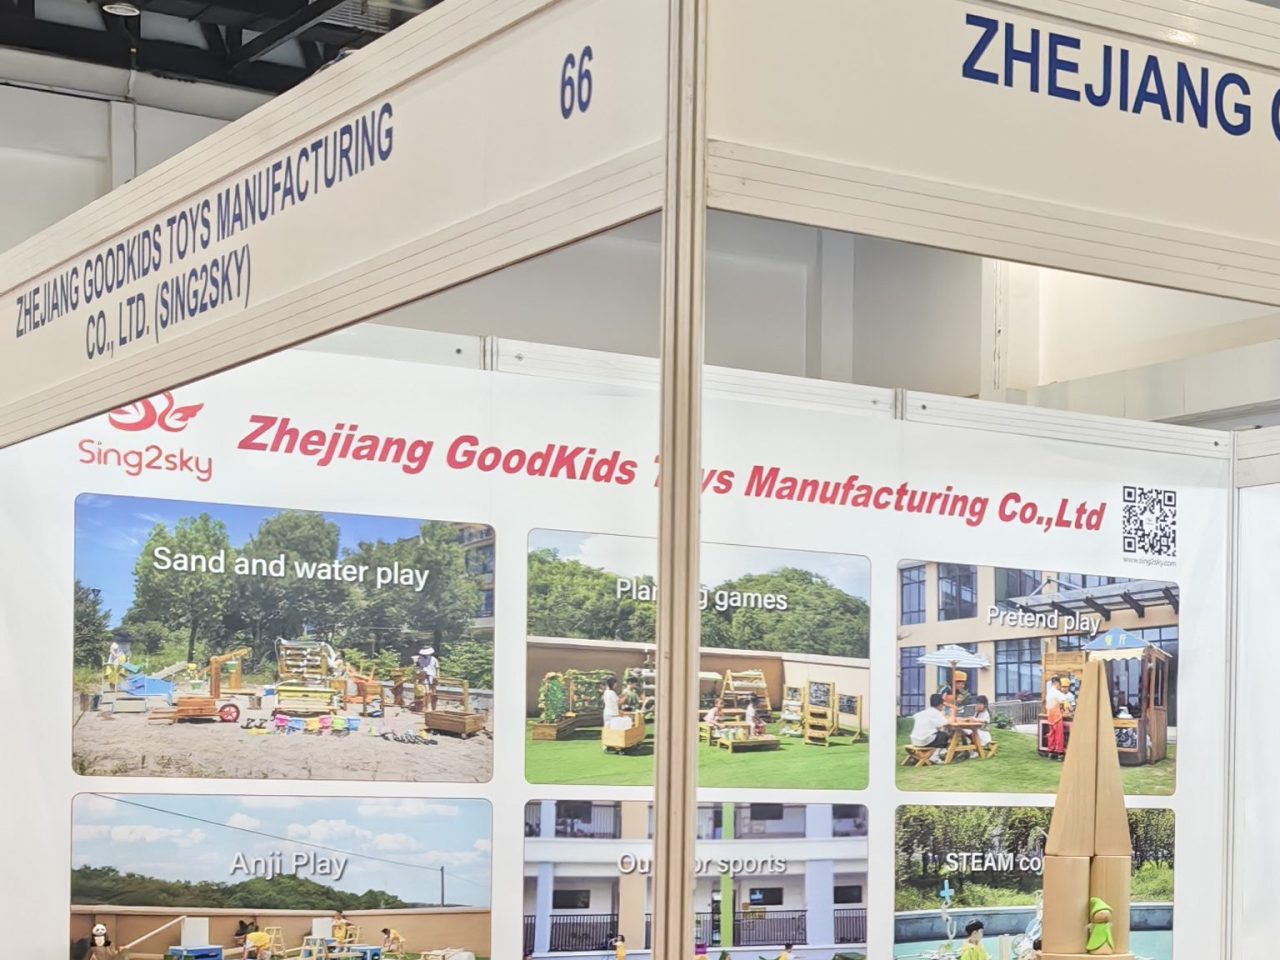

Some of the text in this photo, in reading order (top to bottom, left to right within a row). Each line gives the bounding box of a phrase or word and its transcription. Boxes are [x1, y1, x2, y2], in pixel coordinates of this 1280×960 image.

[560, 45, 593, 119] 66
[962, 13, 1251, 136] ZHEJIANG
[16, 102, 394, 338] ZHEJIANG GOODKIDS TOYS MANUFACTURING
[86, 244, 252, 360] CO., LTD. (SING2SKY)
[78, 438, 213, 482] Sing2sky
[237, 414, 1107, 532] Zhejiang GoodKids ys Manufacturing Co.,Ltd
[152, 547, 429, 591] Sand and water play
[714, 590, 788, 612] games
[987, 607, 1101, 634] Pretend play
[229, 851, 348, 880] Anji Play
[718, 856, 788, 877] sports
[945, 852, 1014, 872] STEAM
